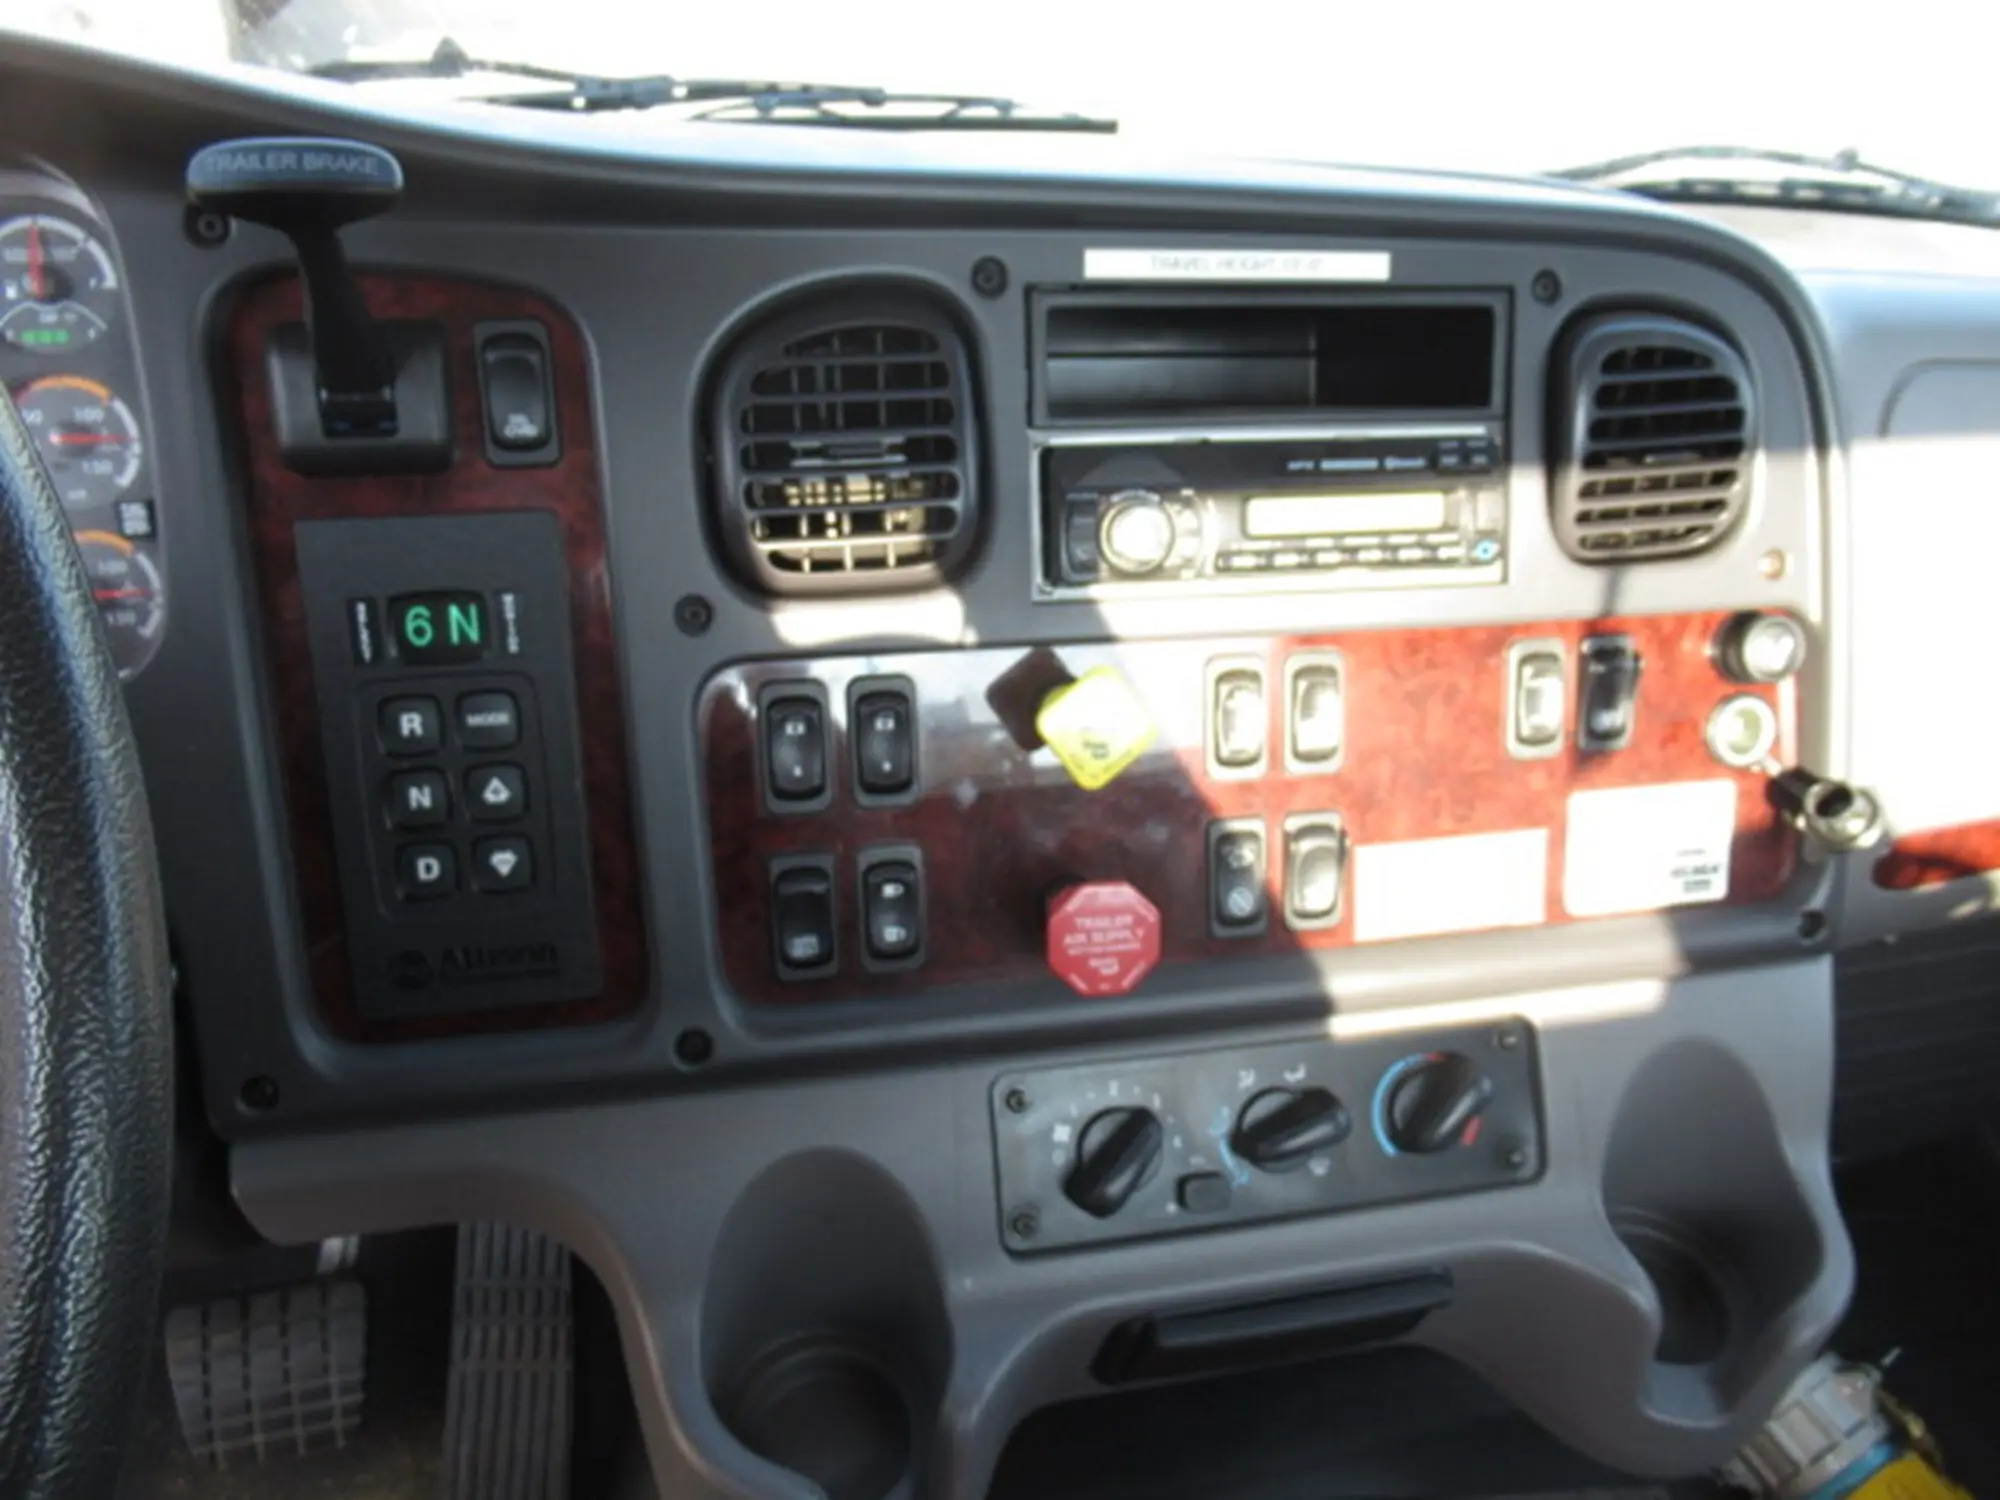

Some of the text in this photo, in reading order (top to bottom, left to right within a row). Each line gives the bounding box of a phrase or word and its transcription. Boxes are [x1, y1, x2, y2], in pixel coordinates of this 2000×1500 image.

[207, 151, 379, 176] TRAILER BRAKE
[404, 604, 434, 649] 6
[447, 602, 481, 646] N
[400, 711, 424, 737] R
[408, 785, 433, 810] N
[417, 857, 442, 881] D
